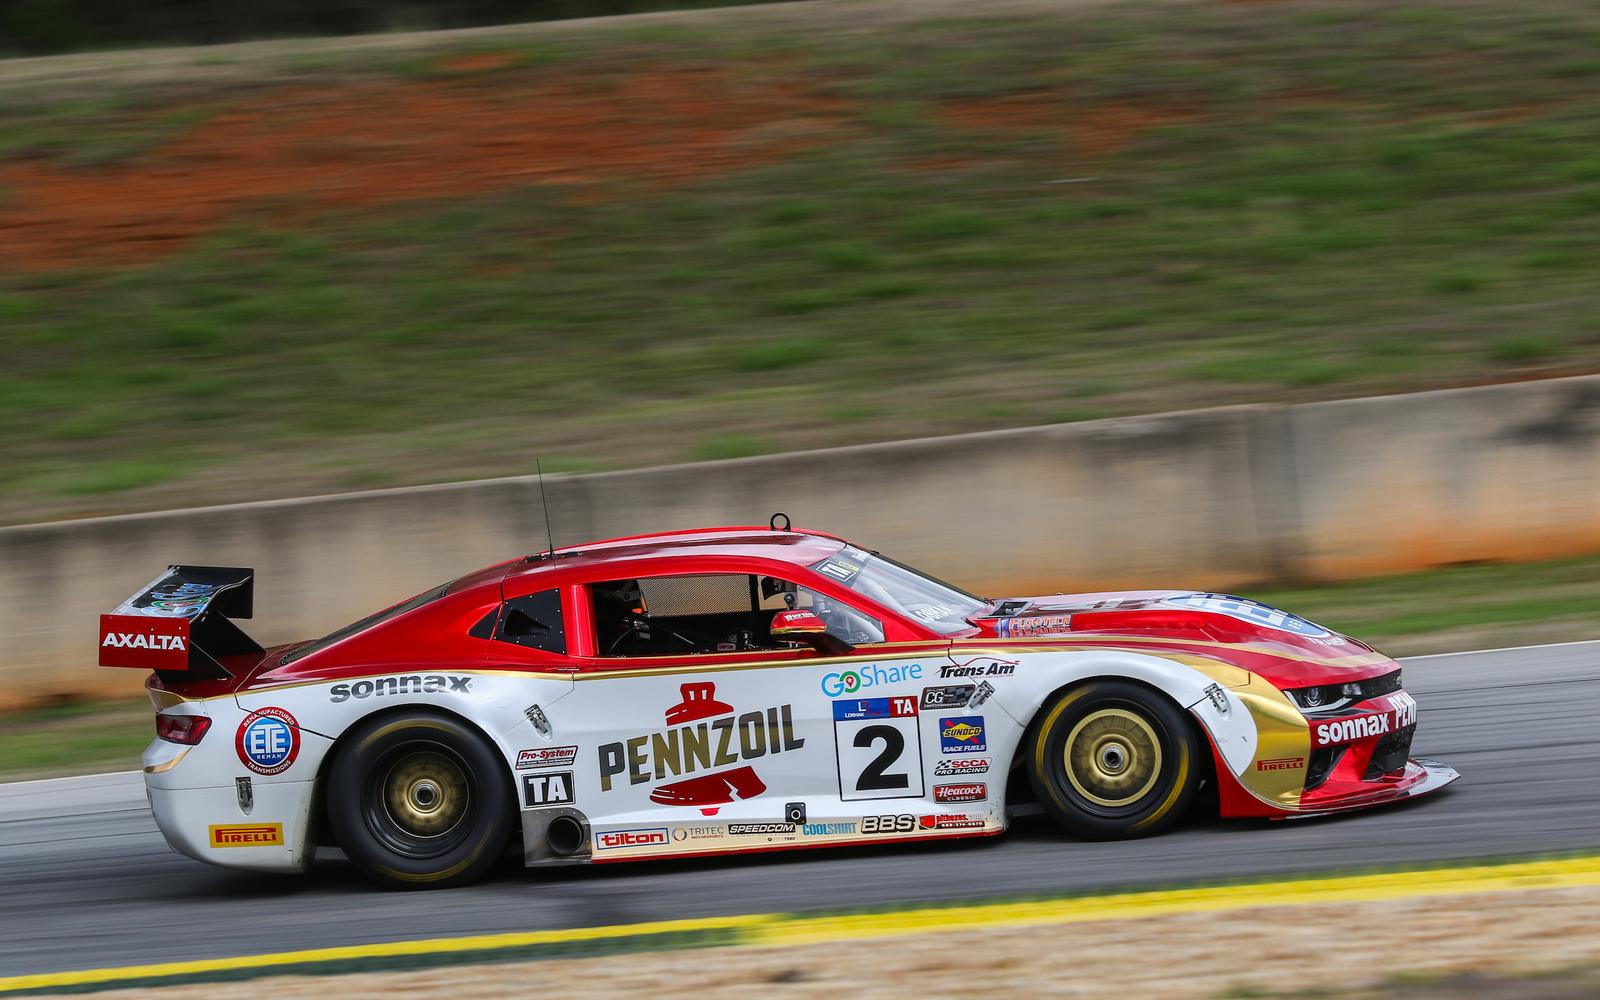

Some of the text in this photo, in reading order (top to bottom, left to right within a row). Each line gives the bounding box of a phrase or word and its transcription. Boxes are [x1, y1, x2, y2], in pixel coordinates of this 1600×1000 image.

[102, 632, 186, 651] AXALTA
[940, 662, 1016, 679] Trans Am
[330, 675, 473, 704] sonnax
[925, 691, 944, 704] CG
[893, 698, 914, 714] TA
[243, 709, 295, 728] REMANUFACTURED
[944, 727, 981, 737] SUNOCO
[1317, 713, 1389, 744] sonnax
[250, 723, 286, 754] ETE
[521, 749, 574, 760] Pro-System
[597, 704, 805, 792] PENNZOIL
[853, 724, 909, 791] 2
[951, 759, 989, 768] SCCA
[1257, 757, 1304, 771] PIRELLI
[247, 760, 292, 774] TRANSMISSIONS
[528, 775, 568, 803] TA
[936, 785, 984, 798] Heacock
[688, 826, 725, 836] TRITEC
[729, 824, 794, 834] SPEEDCOM
[803, 823, 857, 836] COOLSHIRT
[861, 814, 917, 833] BBS
[215, 827, 277, 843] PIRELLI
[601, 833, 664, 846] tilton
